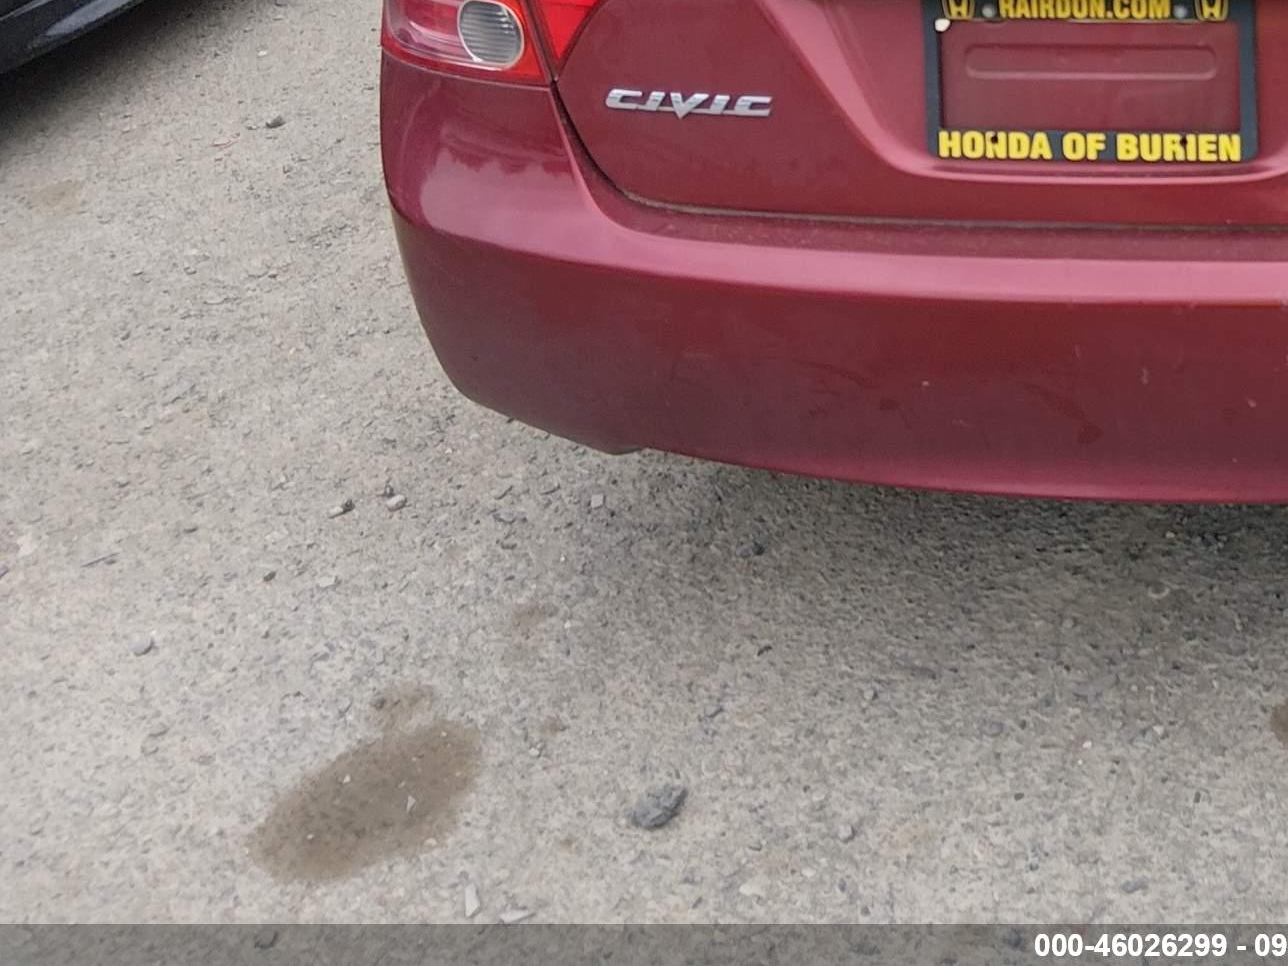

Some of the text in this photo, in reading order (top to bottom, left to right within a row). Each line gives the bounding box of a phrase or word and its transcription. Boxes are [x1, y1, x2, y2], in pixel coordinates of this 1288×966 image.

[605, 88, 772, 120] CIVIC
[938, 131, 1241, 162] HONDA OF BURIEN
